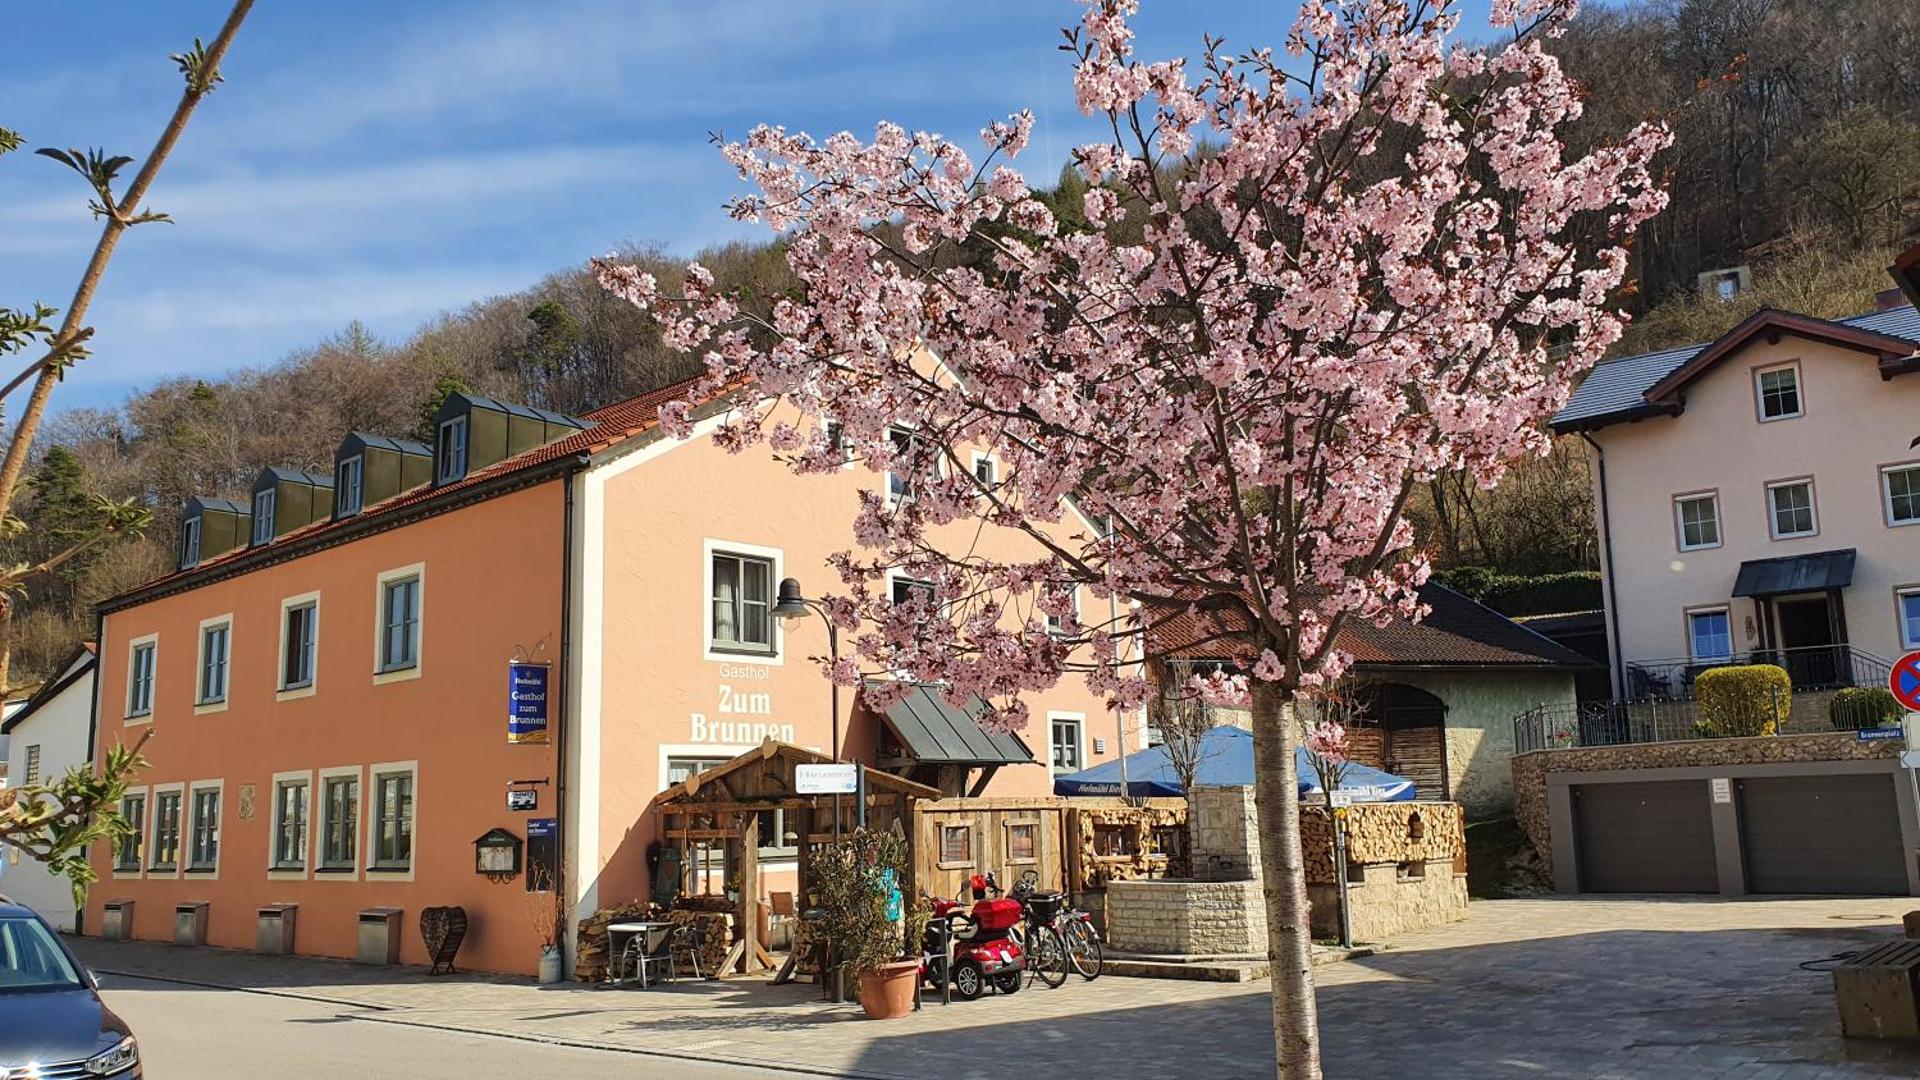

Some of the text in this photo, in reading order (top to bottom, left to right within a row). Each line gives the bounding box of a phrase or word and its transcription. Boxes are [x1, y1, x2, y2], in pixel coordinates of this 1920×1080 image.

[719, 663, 769, 680] Gasthof
[511, 691, 545, 701] Gasthof
[718, 684, 771, 714] Zum
[509, 714, 546, 724] Brunnen
[690, 713, 795, 744] Brunnen
